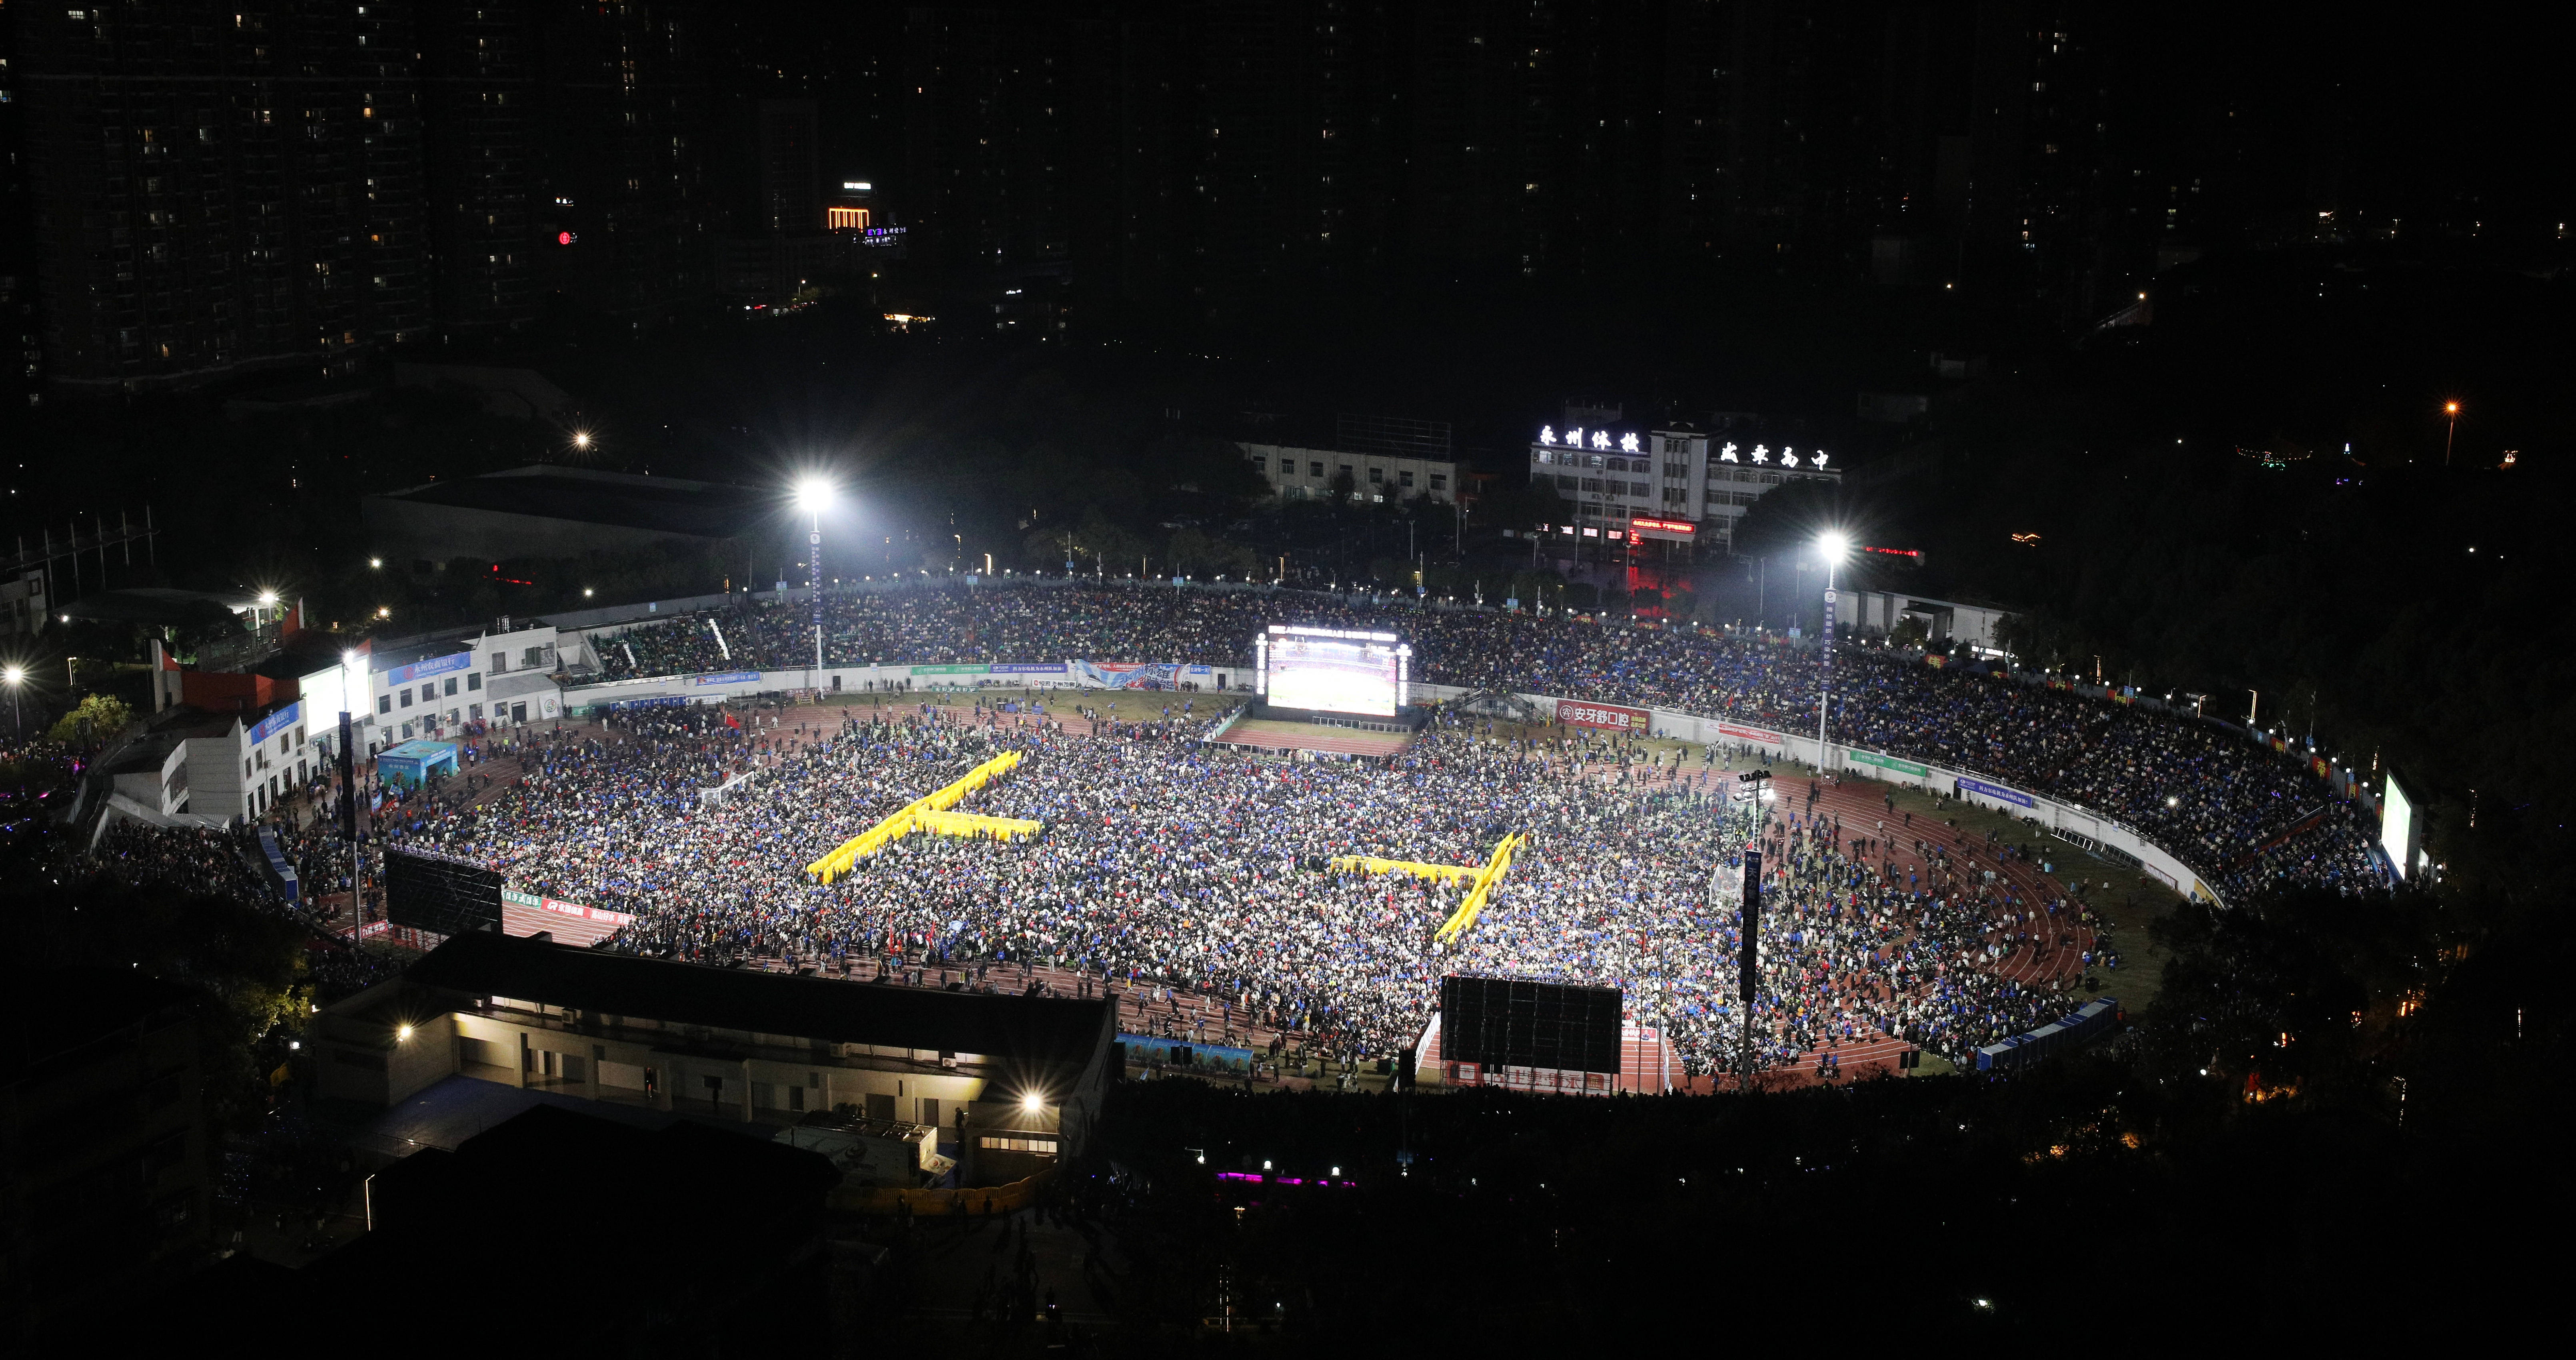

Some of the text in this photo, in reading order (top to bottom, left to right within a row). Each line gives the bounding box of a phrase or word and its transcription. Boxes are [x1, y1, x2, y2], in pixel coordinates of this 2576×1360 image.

[1540, 425, 1639, 452] 永州体校
[414, 658, 455, 673] 永州农商银行
[1574, 707, 1629, 727] 安牙舒口腔
[591, 910, 615, 922] 高山好水
